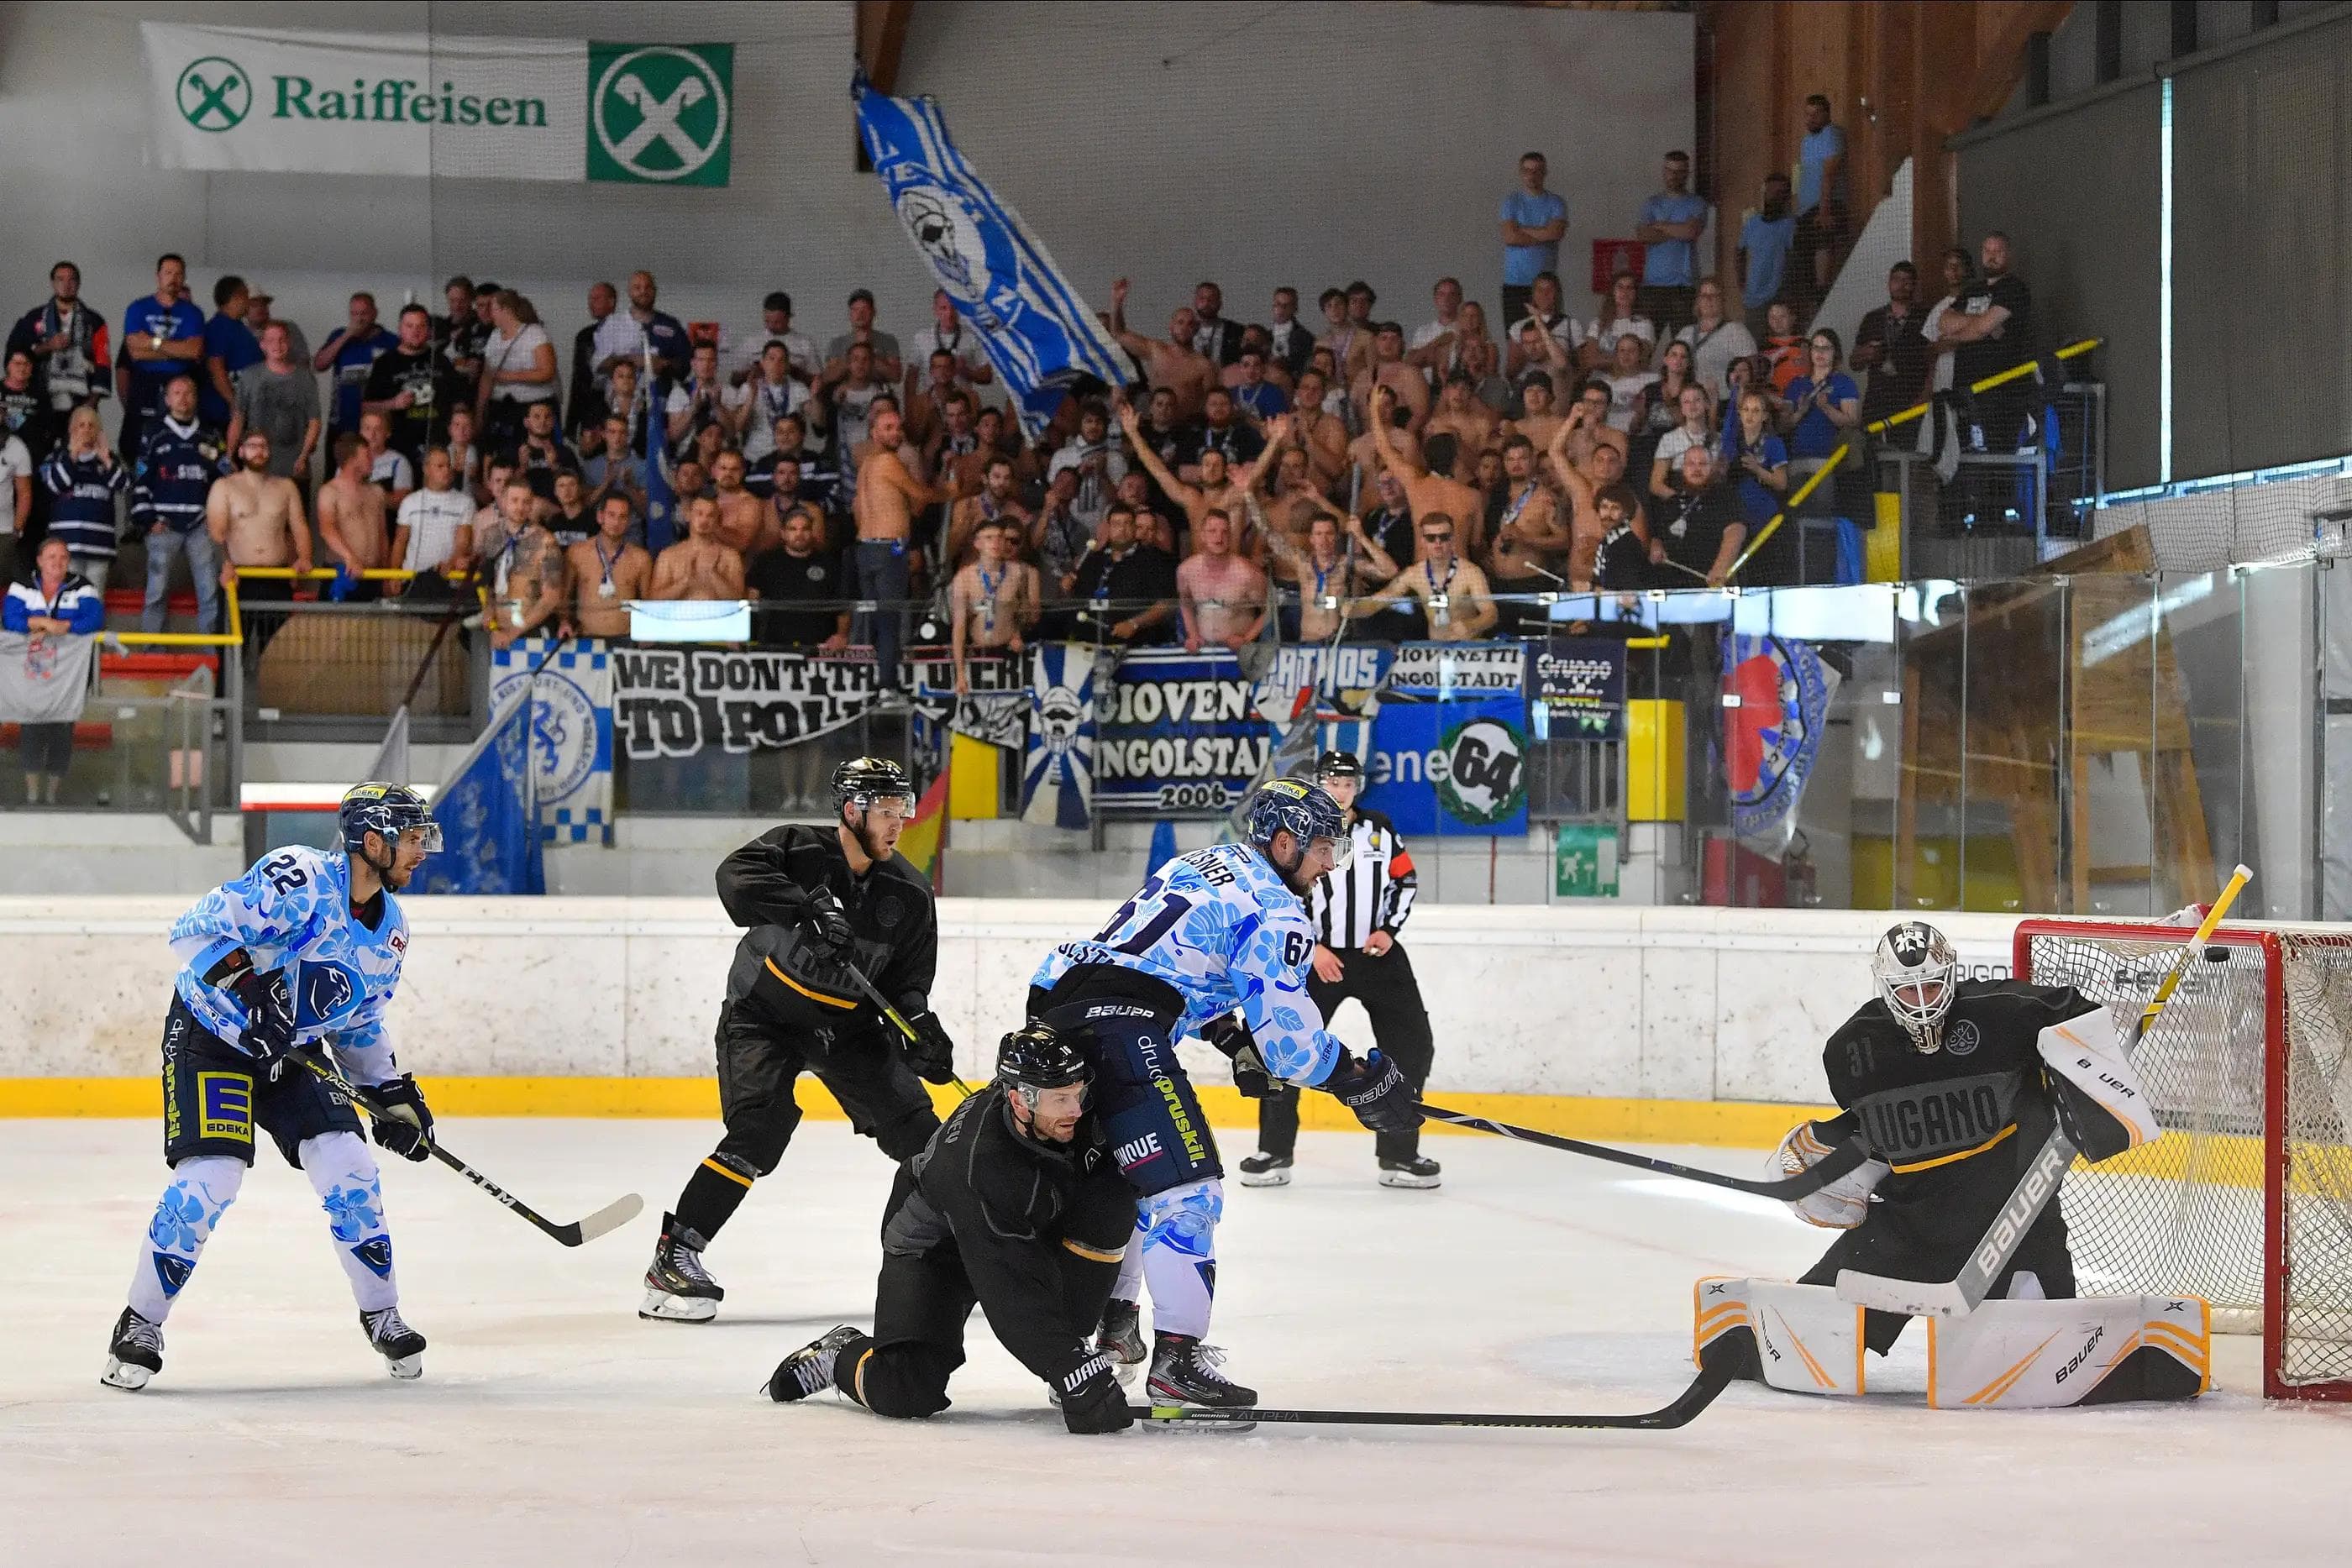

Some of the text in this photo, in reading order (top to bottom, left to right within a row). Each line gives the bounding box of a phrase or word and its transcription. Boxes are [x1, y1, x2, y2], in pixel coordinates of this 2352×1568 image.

[271, 75, 548, 127] Raiffeisen
[614, 653, 682, 691] WE
[1395, 648, 1519, 663] IOVNETTI
[1094, 680, 1249, 724] GIOVEN
[618, 697, 699, 753] TO
[1090, 736, 1272, 779] INGOLSTA
[1453, 736, 1520, 800] 64
[1159, 781, 1228, 809] 2006
[261, 854, 308, 897] 22
[1284, 931, 1312, 967] 61
[1058, 1045, 1073, 1057] 16
[1915, 1025, 1938, 1049] 31
[1347, 1062, 1404, 1106] BAUE
[207, 1123, 249, 1137] EDEKA
[1859, 1085, 2001, 1153] LUGANO
[459, 1164, 517, 1208] CCM
[1977, 1147, 2066, 1278] BAUER
[1063, 1354, 1110, 1392] WARR
[2055, 1325, 2104, 1385] BAUER
